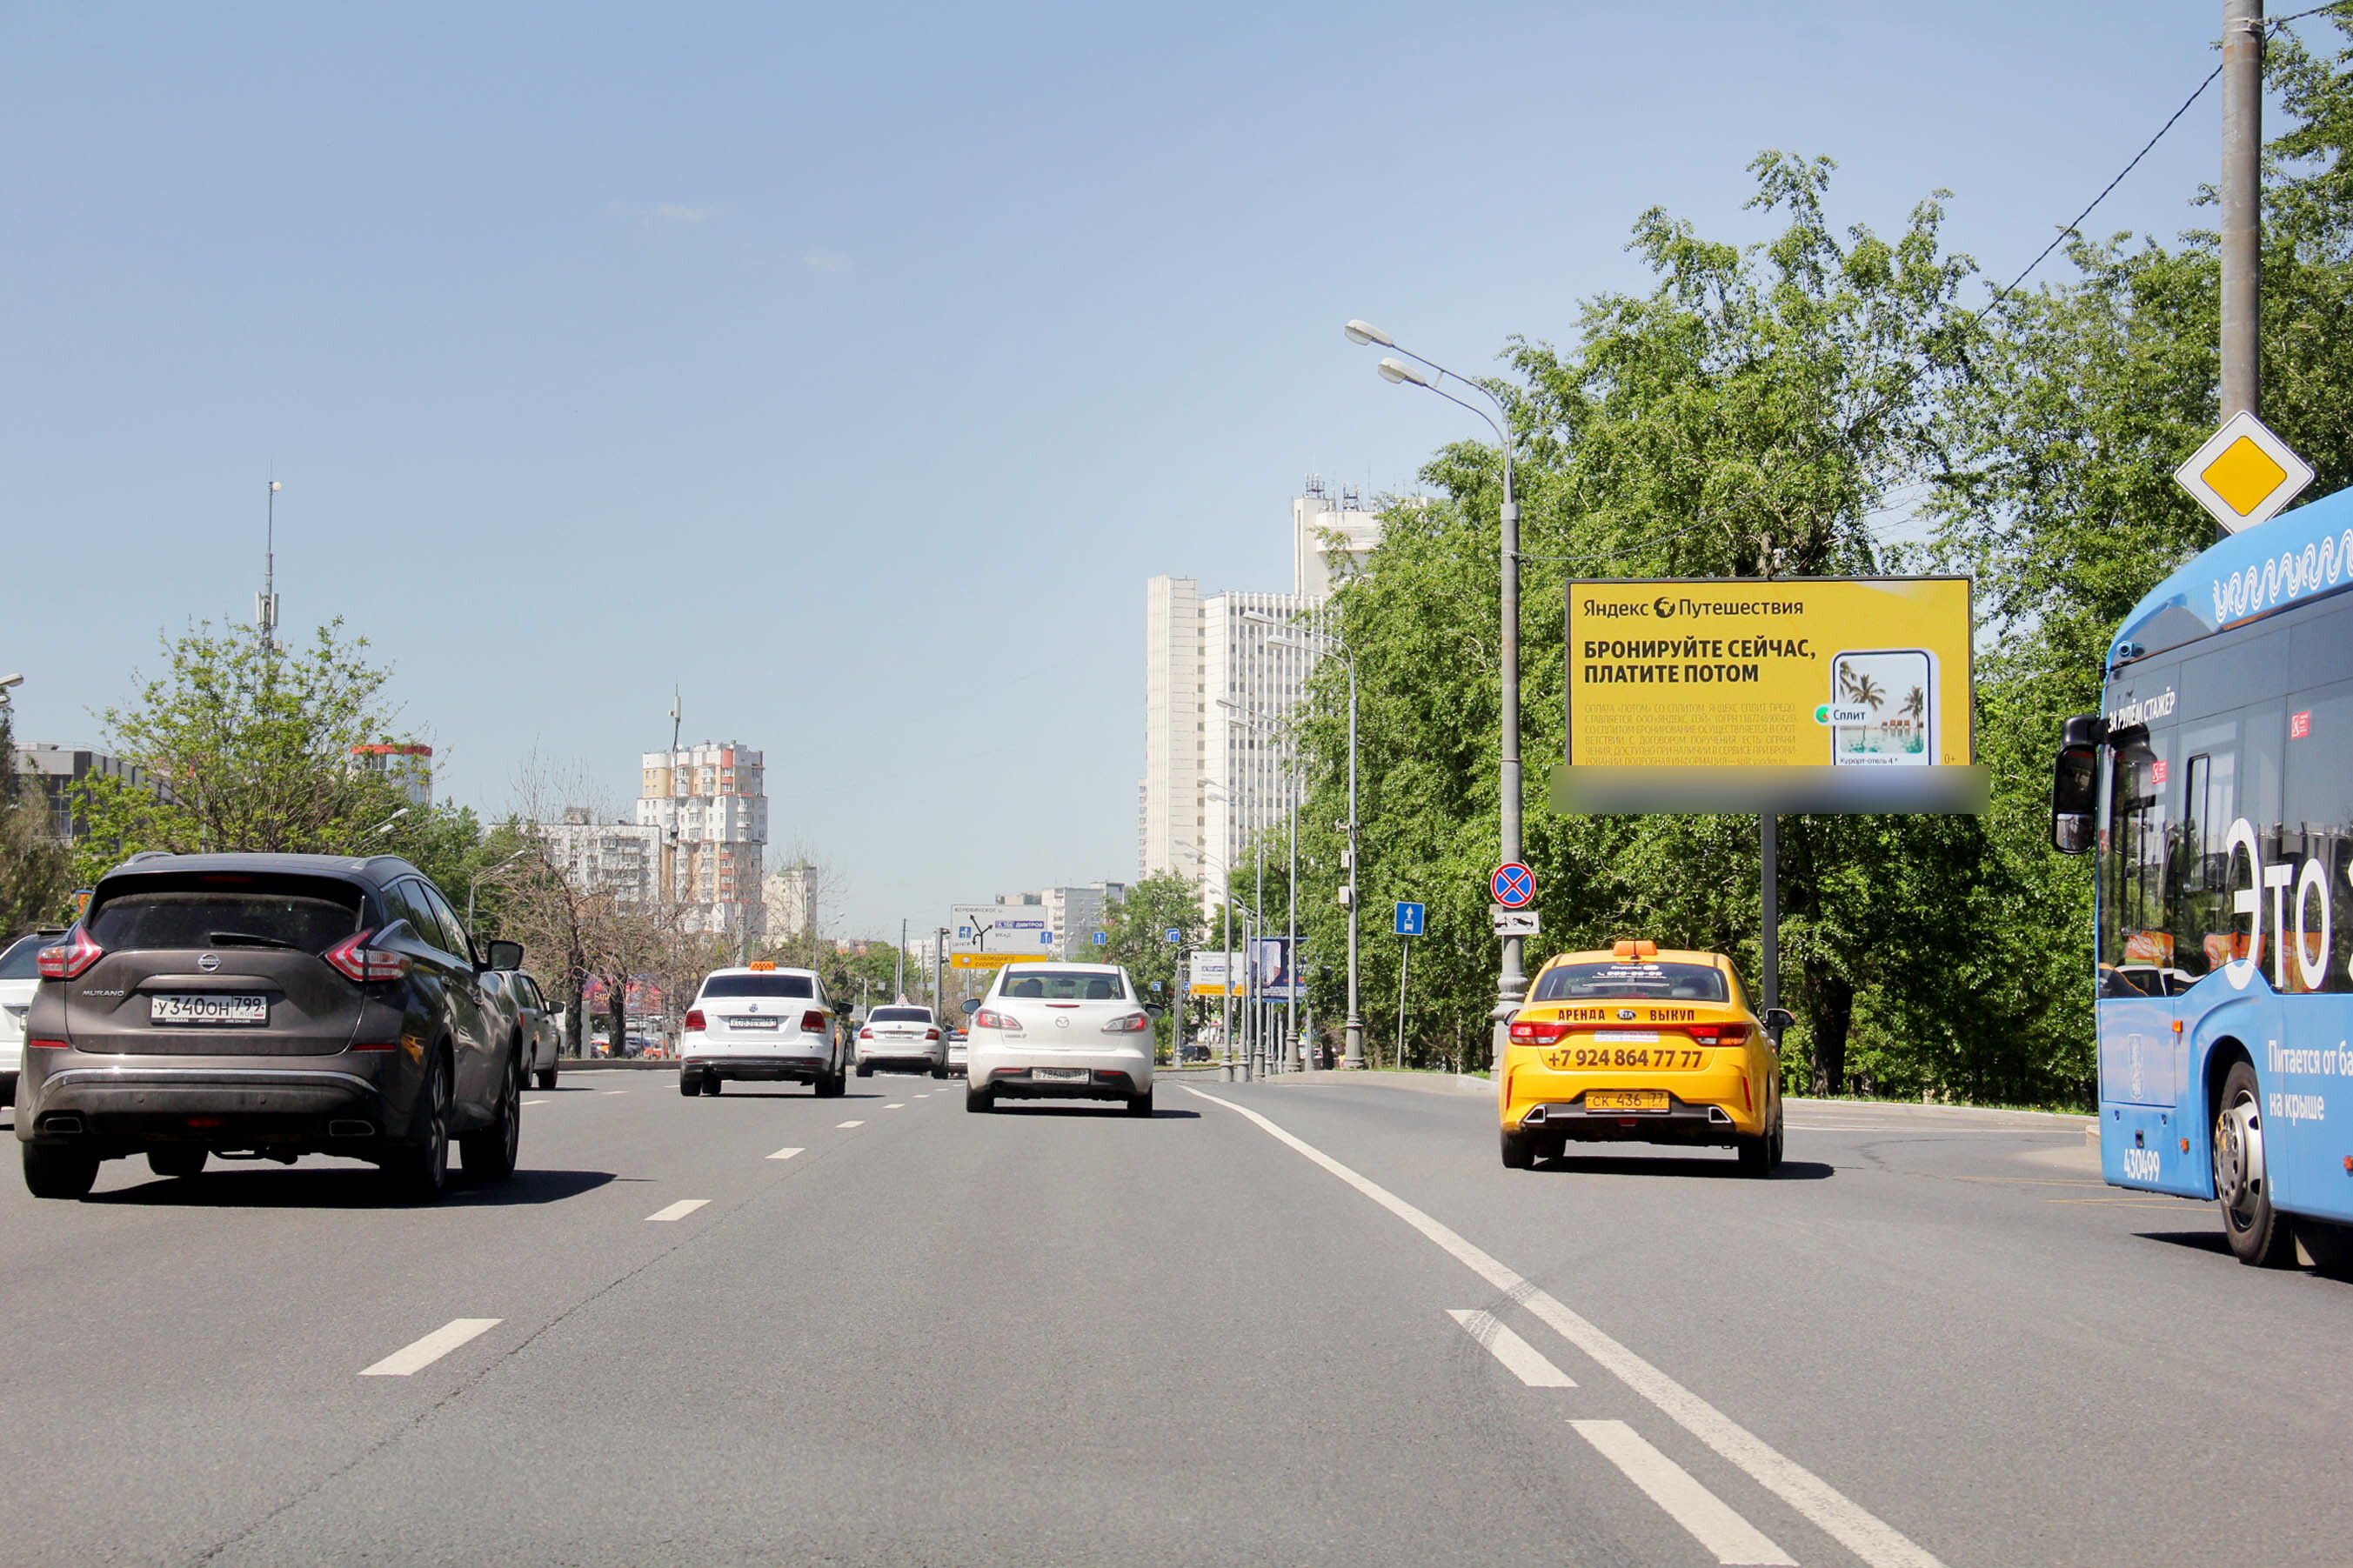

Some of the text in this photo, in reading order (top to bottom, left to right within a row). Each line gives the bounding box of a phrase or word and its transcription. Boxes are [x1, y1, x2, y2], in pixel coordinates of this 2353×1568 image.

[1583, 598, 1804, 618] Яндекс Путешествия
[1583, 635, 1816, 660] БРОНИРУЙТЕ СЕЙЧАС,
[1584, 664, 1759, 683] ПЛАТИТЕ ПОТОМ
[1833, 709, 1866, 722] Сплит
[1943, 753, 1956, 764] 0+
[2224, 817, 2331, 991] Это
[1558, 1009, 1606, 1021] АРЕНДА
[1649, 1009, 1695, 1021] ВЫКУП
[1548, 1049, 1703, 1068] +7 924 864 77 77
[2268, 1039, 2321, 1074] Питается
[2323, 1050, 2336, 1075] от
[2269, 1092, 2325, 1127] на крыше
[2123, 1149, 2161, 1182] 430499
